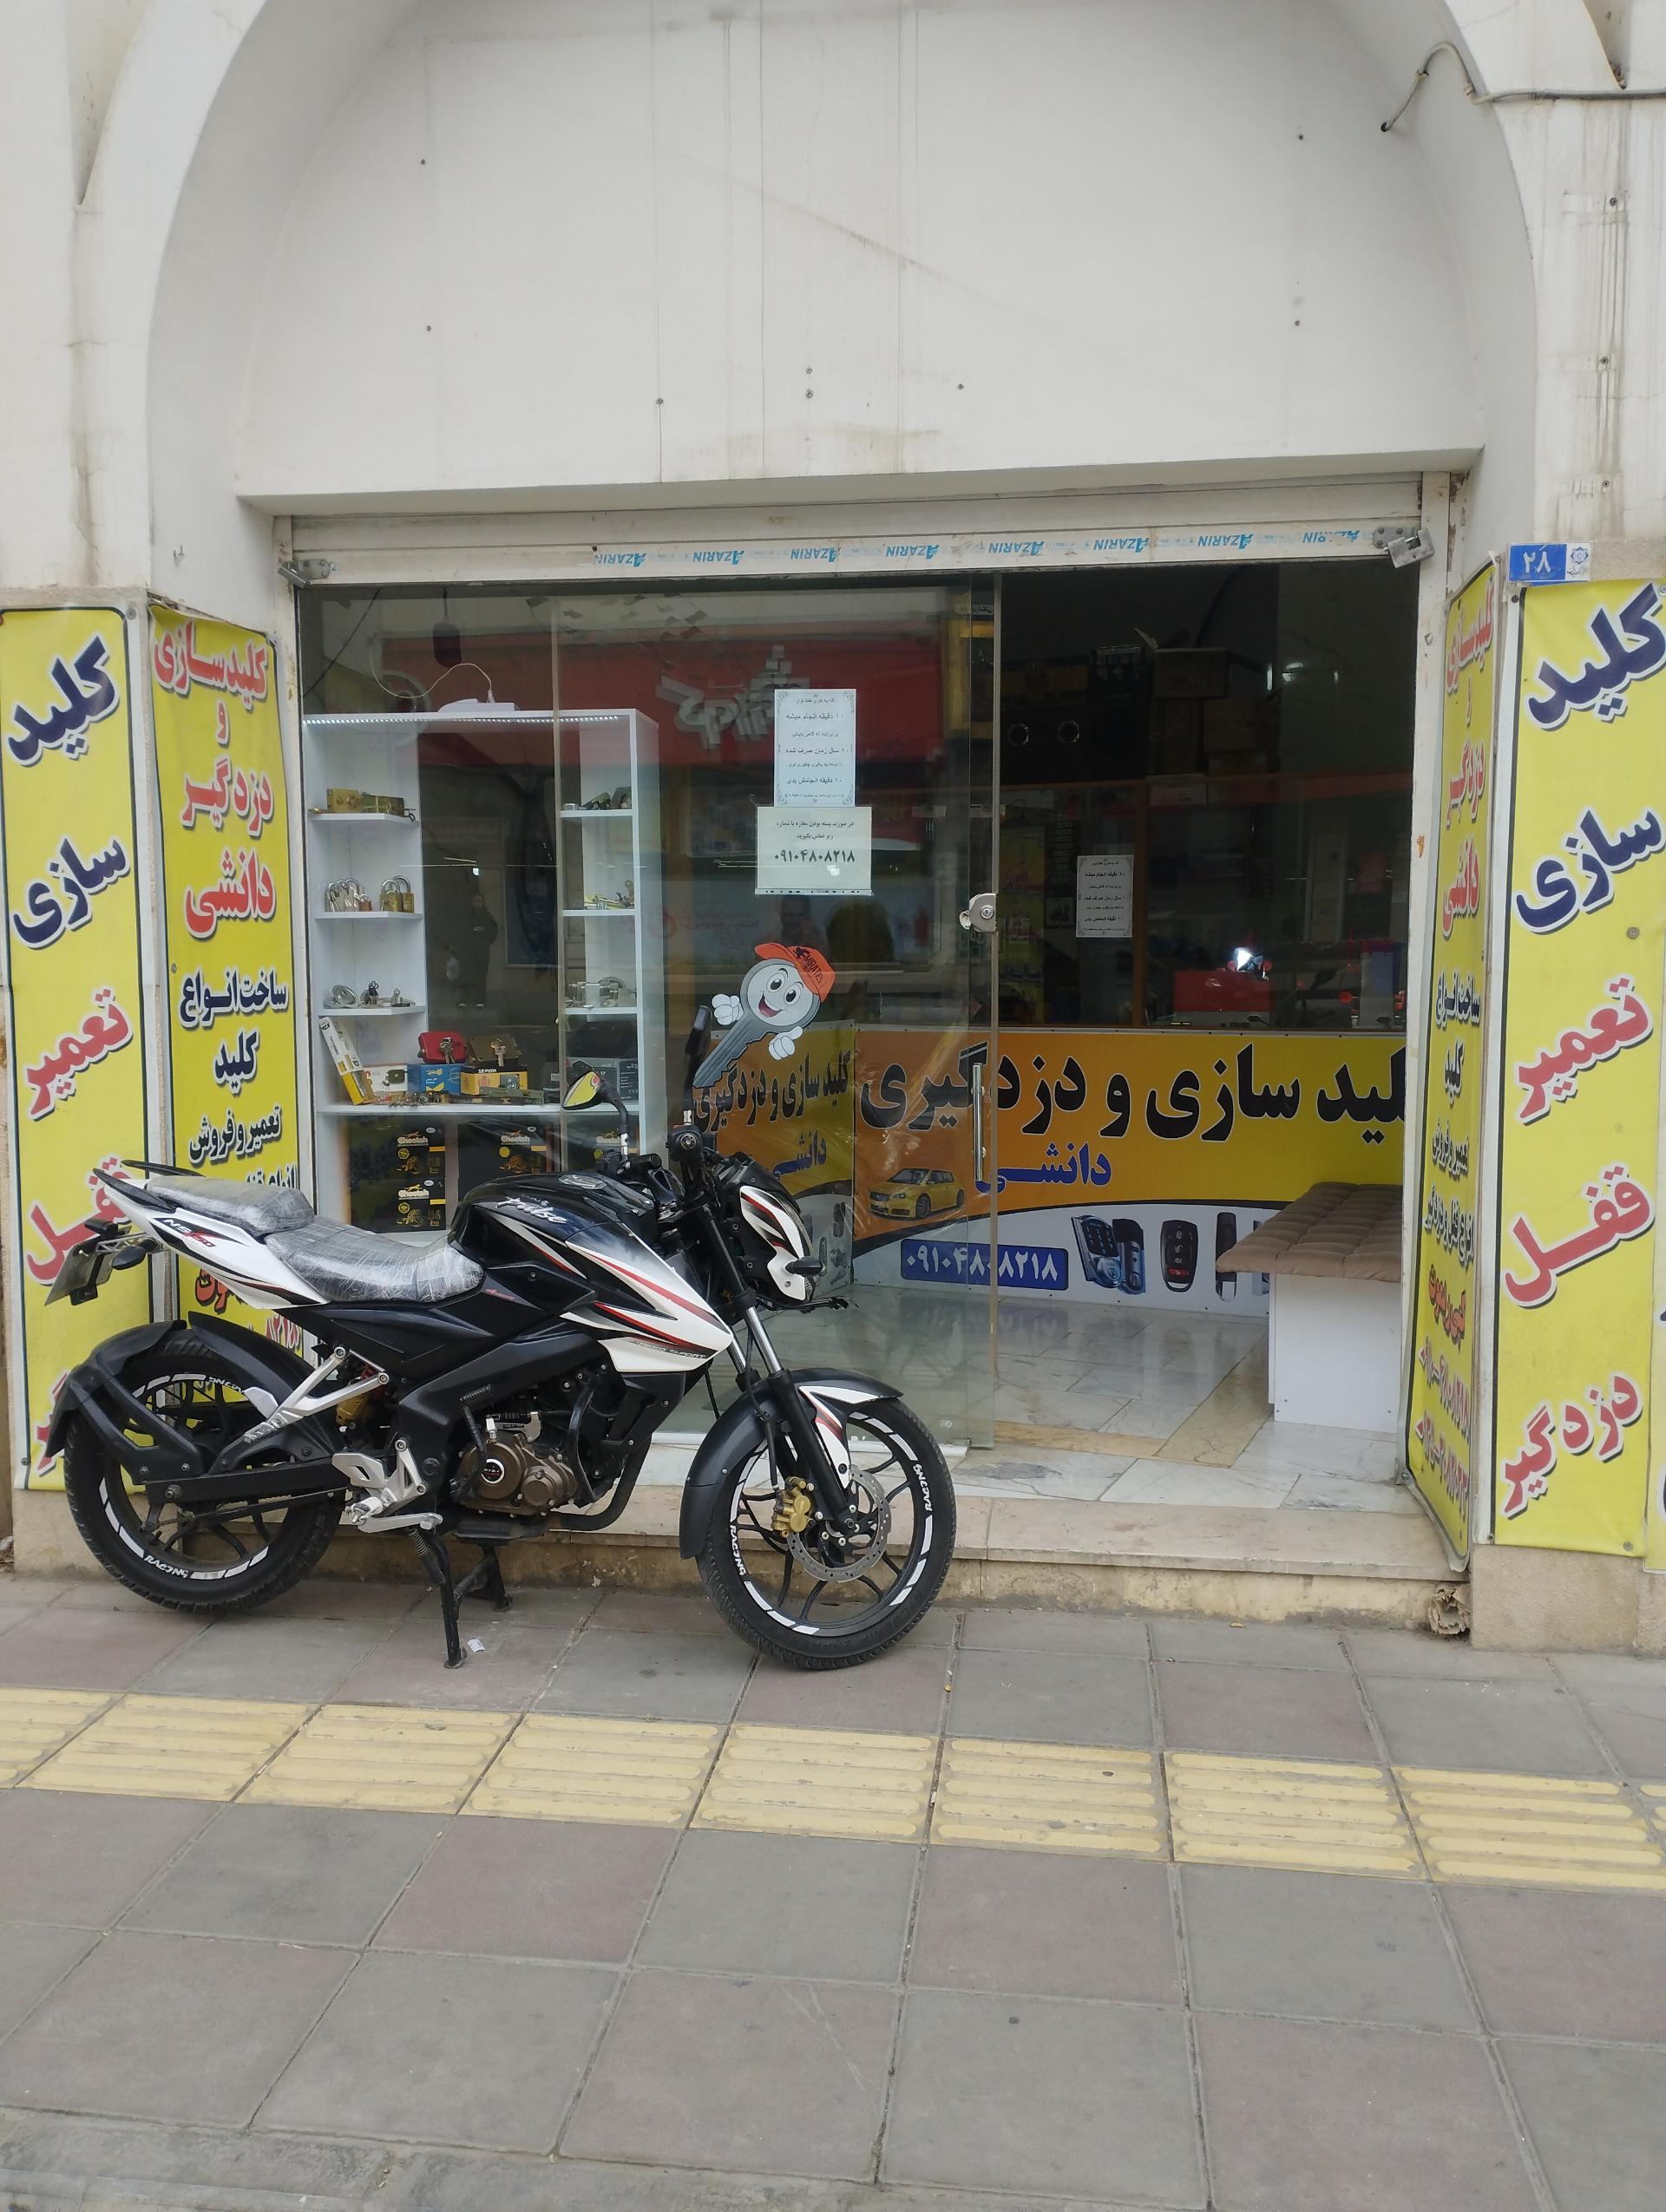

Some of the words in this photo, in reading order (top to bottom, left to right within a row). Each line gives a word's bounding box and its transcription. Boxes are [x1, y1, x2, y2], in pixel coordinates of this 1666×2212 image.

[692, 549, 744, 565] AZARIN
[790, 546, 841, 563] AZARIN
[885, 544, 939, 560] AZARIN
[988, 540, 1045, 556] AZARIN
[1093, 537, 1150, 553] AZARIN
[1197, 533, 1253, 549] AZARIN
[1523, 551, 1551, 573] ۲۸
[1526, 581, 1666, 723] کلید
[6, 633, 121, 760] کلید
[216, 700, 229, 743] و
[803, 712, 817, 721] انجام
[818, 712, 833, 721] دقیقه
[819, 776, 833, 785] دقیقه
[774, 849, 856, 863] ۰۹۱۰۴۸۰۸۲۱۸
[1514, 808, 1663, 931] سازی
[12, 836, 130, 946] سازی
[185, 847, 276, 939] دانشی
[1442, 838, 1480, 939] دانشی
[797, 947, 824, 985] EMIRATES
[25, 986, 133, 1119] تعمیر
[213, 1030, 259, 1093] کلید
[1444, 1039, 1465, 1107] کلید
[1517, 976, 1651, 1122] تعمیر
[769, 1077, 778, 1122] و
[782, 1052, 820, 1119] سازی
[823, 1049, 852, 1108] کلید
[860, 1041, 1088, 1134] دزدگیری
[1145, 1043, 1301, 1142] سازی
[1316, 1044, 1406, 1144] لید
[245, 1104, 281, 1152] تعمیر
[1099, 1072, 1133, 1138] و
[188, 1109, 234, 1162] فروش
[398, 1188, 430, 1197] Cheetah
[973, 1142, 1112, 1194] دانشی
[1502, 1165, 1652, 1307] قفل
[913, 1463, 933, 1512] RACING
[143, 1554, 190, 1579] RACING
[729, 1524, 746, 1576] RACING
